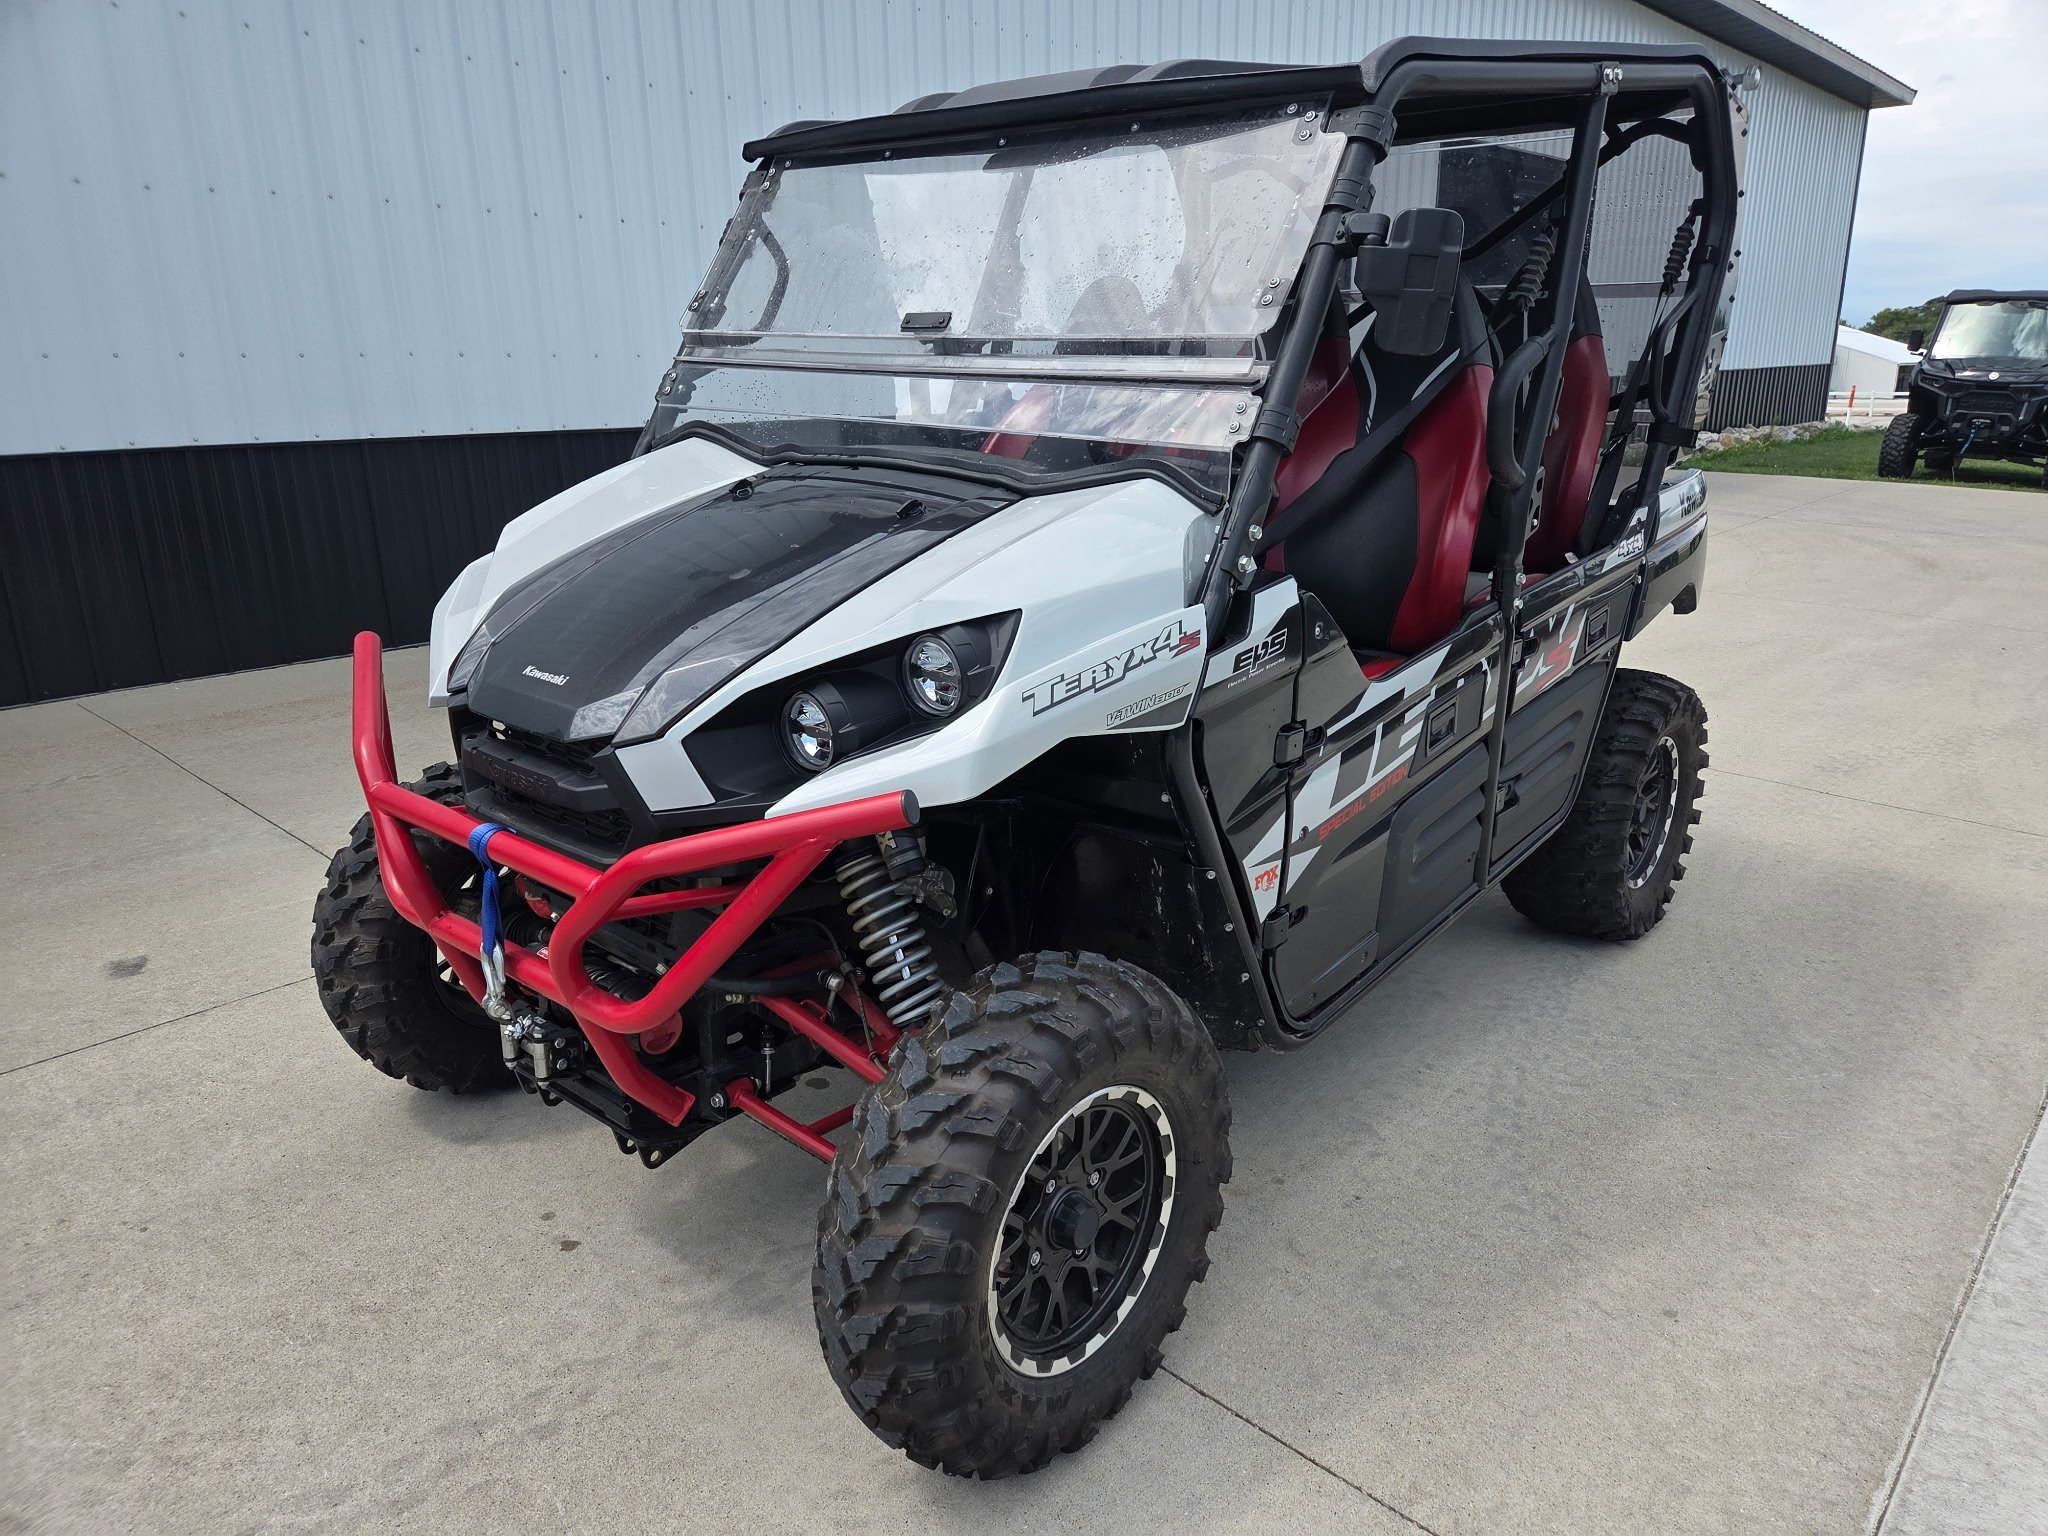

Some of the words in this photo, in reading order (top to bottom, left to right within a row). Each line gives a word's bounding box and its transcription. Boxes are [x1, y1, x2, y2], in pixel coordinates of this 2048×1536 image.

[1232, 627, 1288, 674] EPS
[521, 664, 570, 686] Kawasaki
[1248, 667, 1265, 679] Power
[1318, 800, 1366, 842] SPECIAL
[1369, 763, 1409, 804] EDITION
[1254, 864, 1279, 892] FOX
